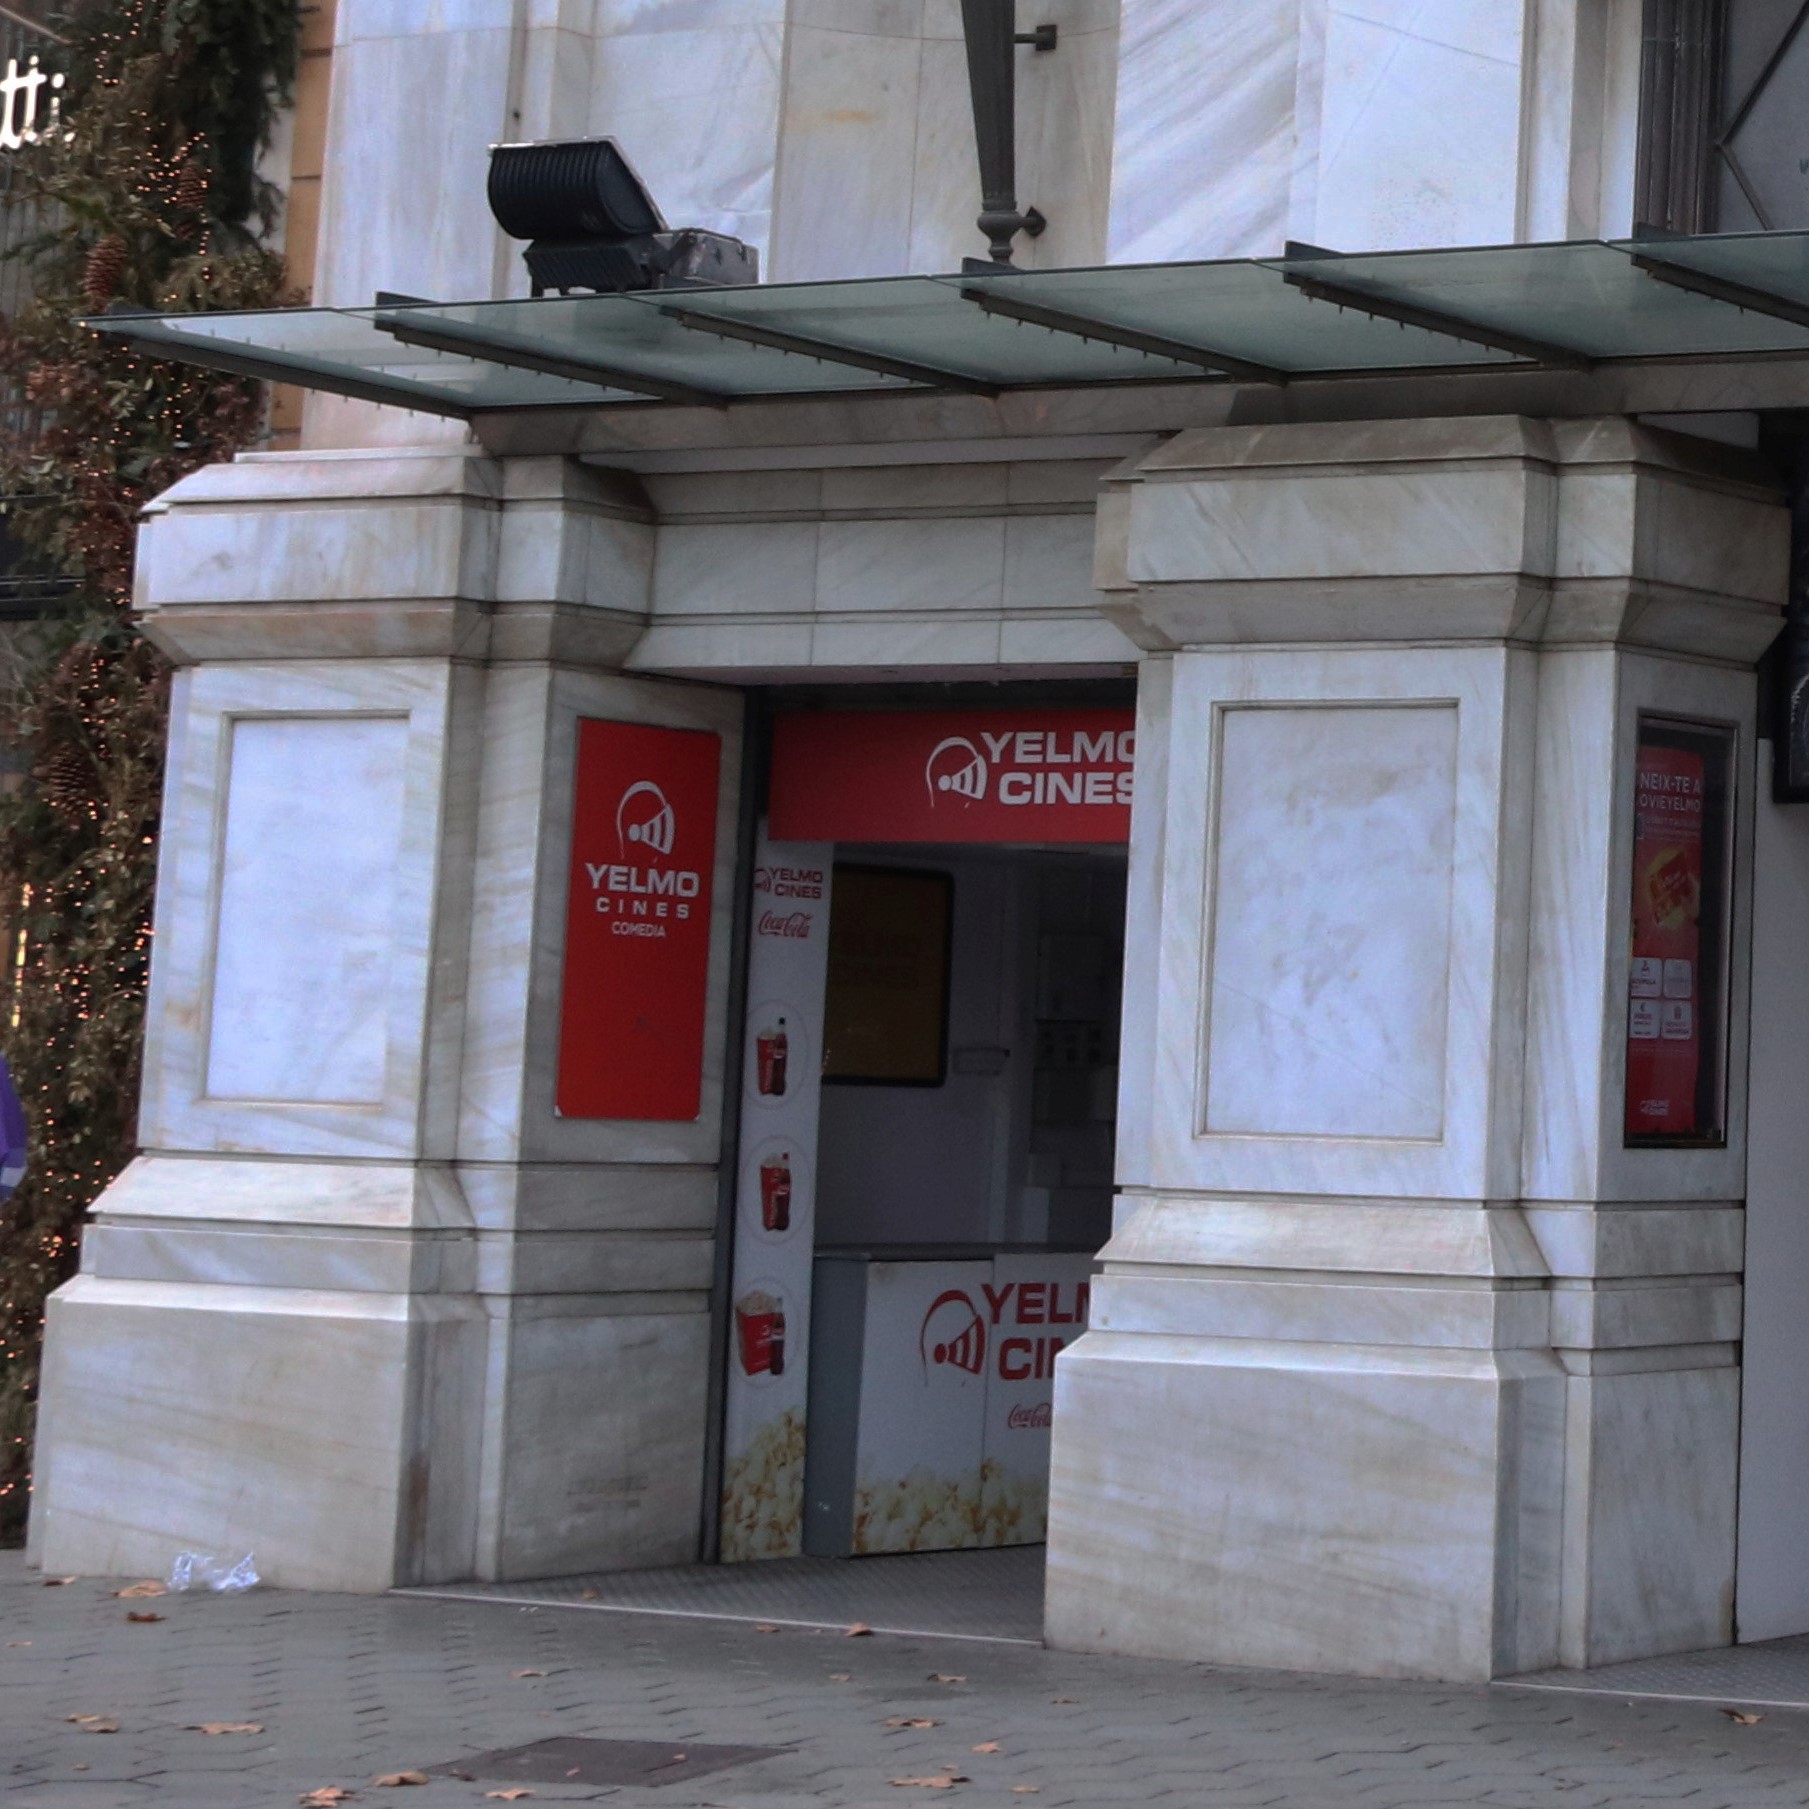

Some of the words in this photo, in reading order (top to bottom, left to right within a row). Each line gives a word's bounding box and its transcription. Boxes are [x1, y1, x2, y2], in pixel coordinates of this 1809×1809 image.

[585, 862, 701, 898] YELMO
[769, 868, 823, 884] YELMO
[774, 883, 822, 900] CINES
[595, 896, 690, 920] CINES
[611, 921, 667, 938] COMEDIA
